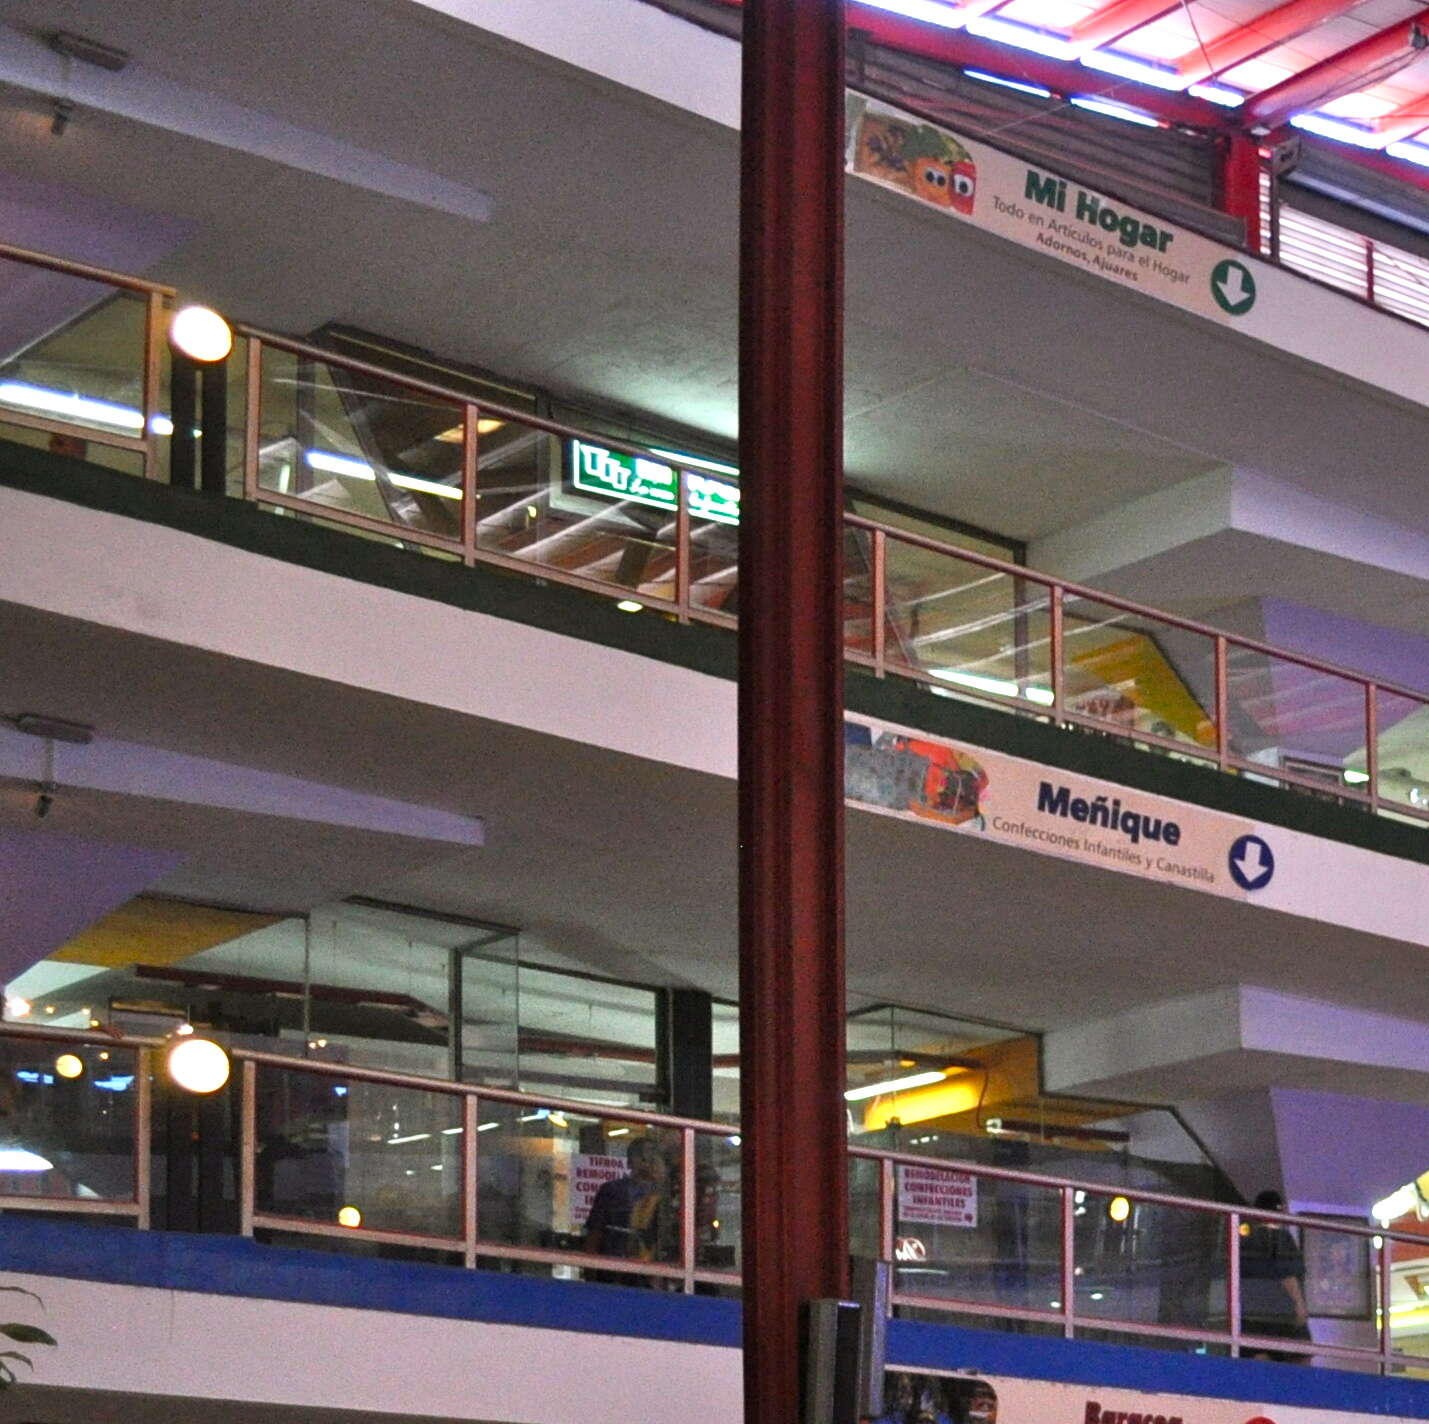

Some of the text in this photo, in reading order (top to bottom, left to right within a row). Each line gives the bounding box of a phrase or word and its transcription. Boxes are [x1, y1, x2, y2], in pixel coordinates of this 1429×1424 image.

[993, 196, 1024, 219] Todo
[1029, 212, 1044, 226] en
[1107, 244, 1135, 262] para
[1138, 254, 1150, 268] el
[1154, 260, 1190, 284] Hogar
[1025, 170, 1173, 253] Mi Hogar
[1036, 232, 1138, 282] Adornos, Ajuares
[1037, 781, 1181, 846] Meñique
[992, 816, 1216, 884] Confecciones Infantiles y Canastilla
